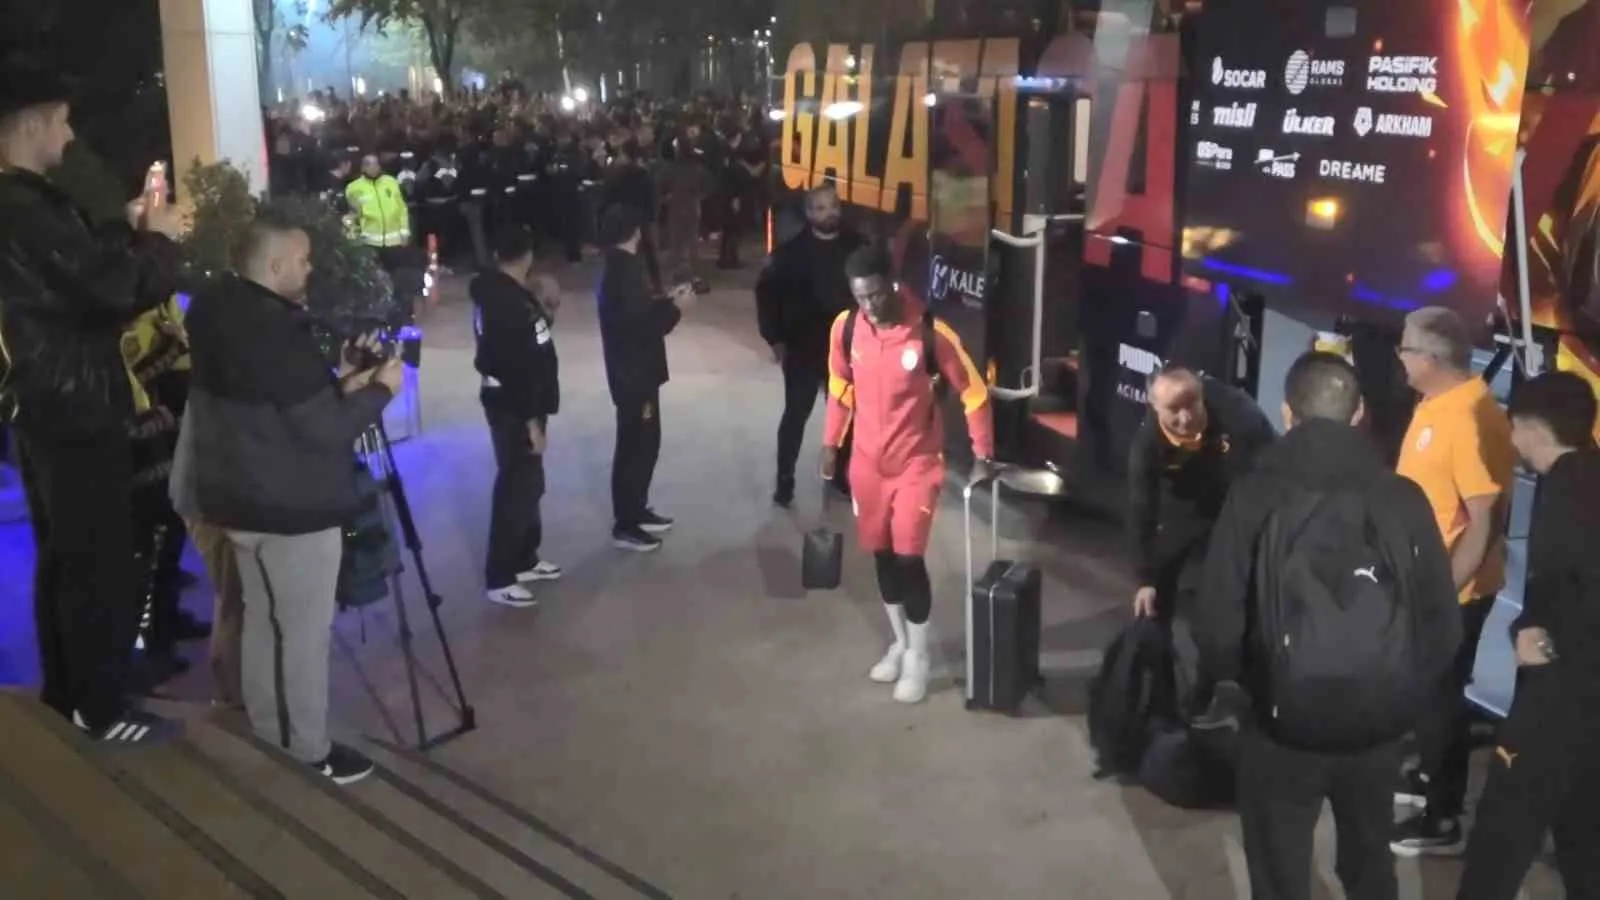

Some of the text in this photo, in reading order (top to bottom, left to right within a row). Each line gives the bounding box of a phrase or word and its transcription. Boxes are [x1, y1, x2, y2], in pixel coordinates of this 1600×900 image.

[1223, 69, 1267, 88] SOCAR
[1310, 60, 1345, 76] RAMS
[1213, 102, 1257, 128] misli
[1282, 108, 1336, 136] ÜLKER
[1375, 114, 1432, 137] ARKHAM
[1319, 159, 1386, 184] DREAME
[949, 267, 985, 298] KALE
[1116, 383, 1148, 404] ACIBA
